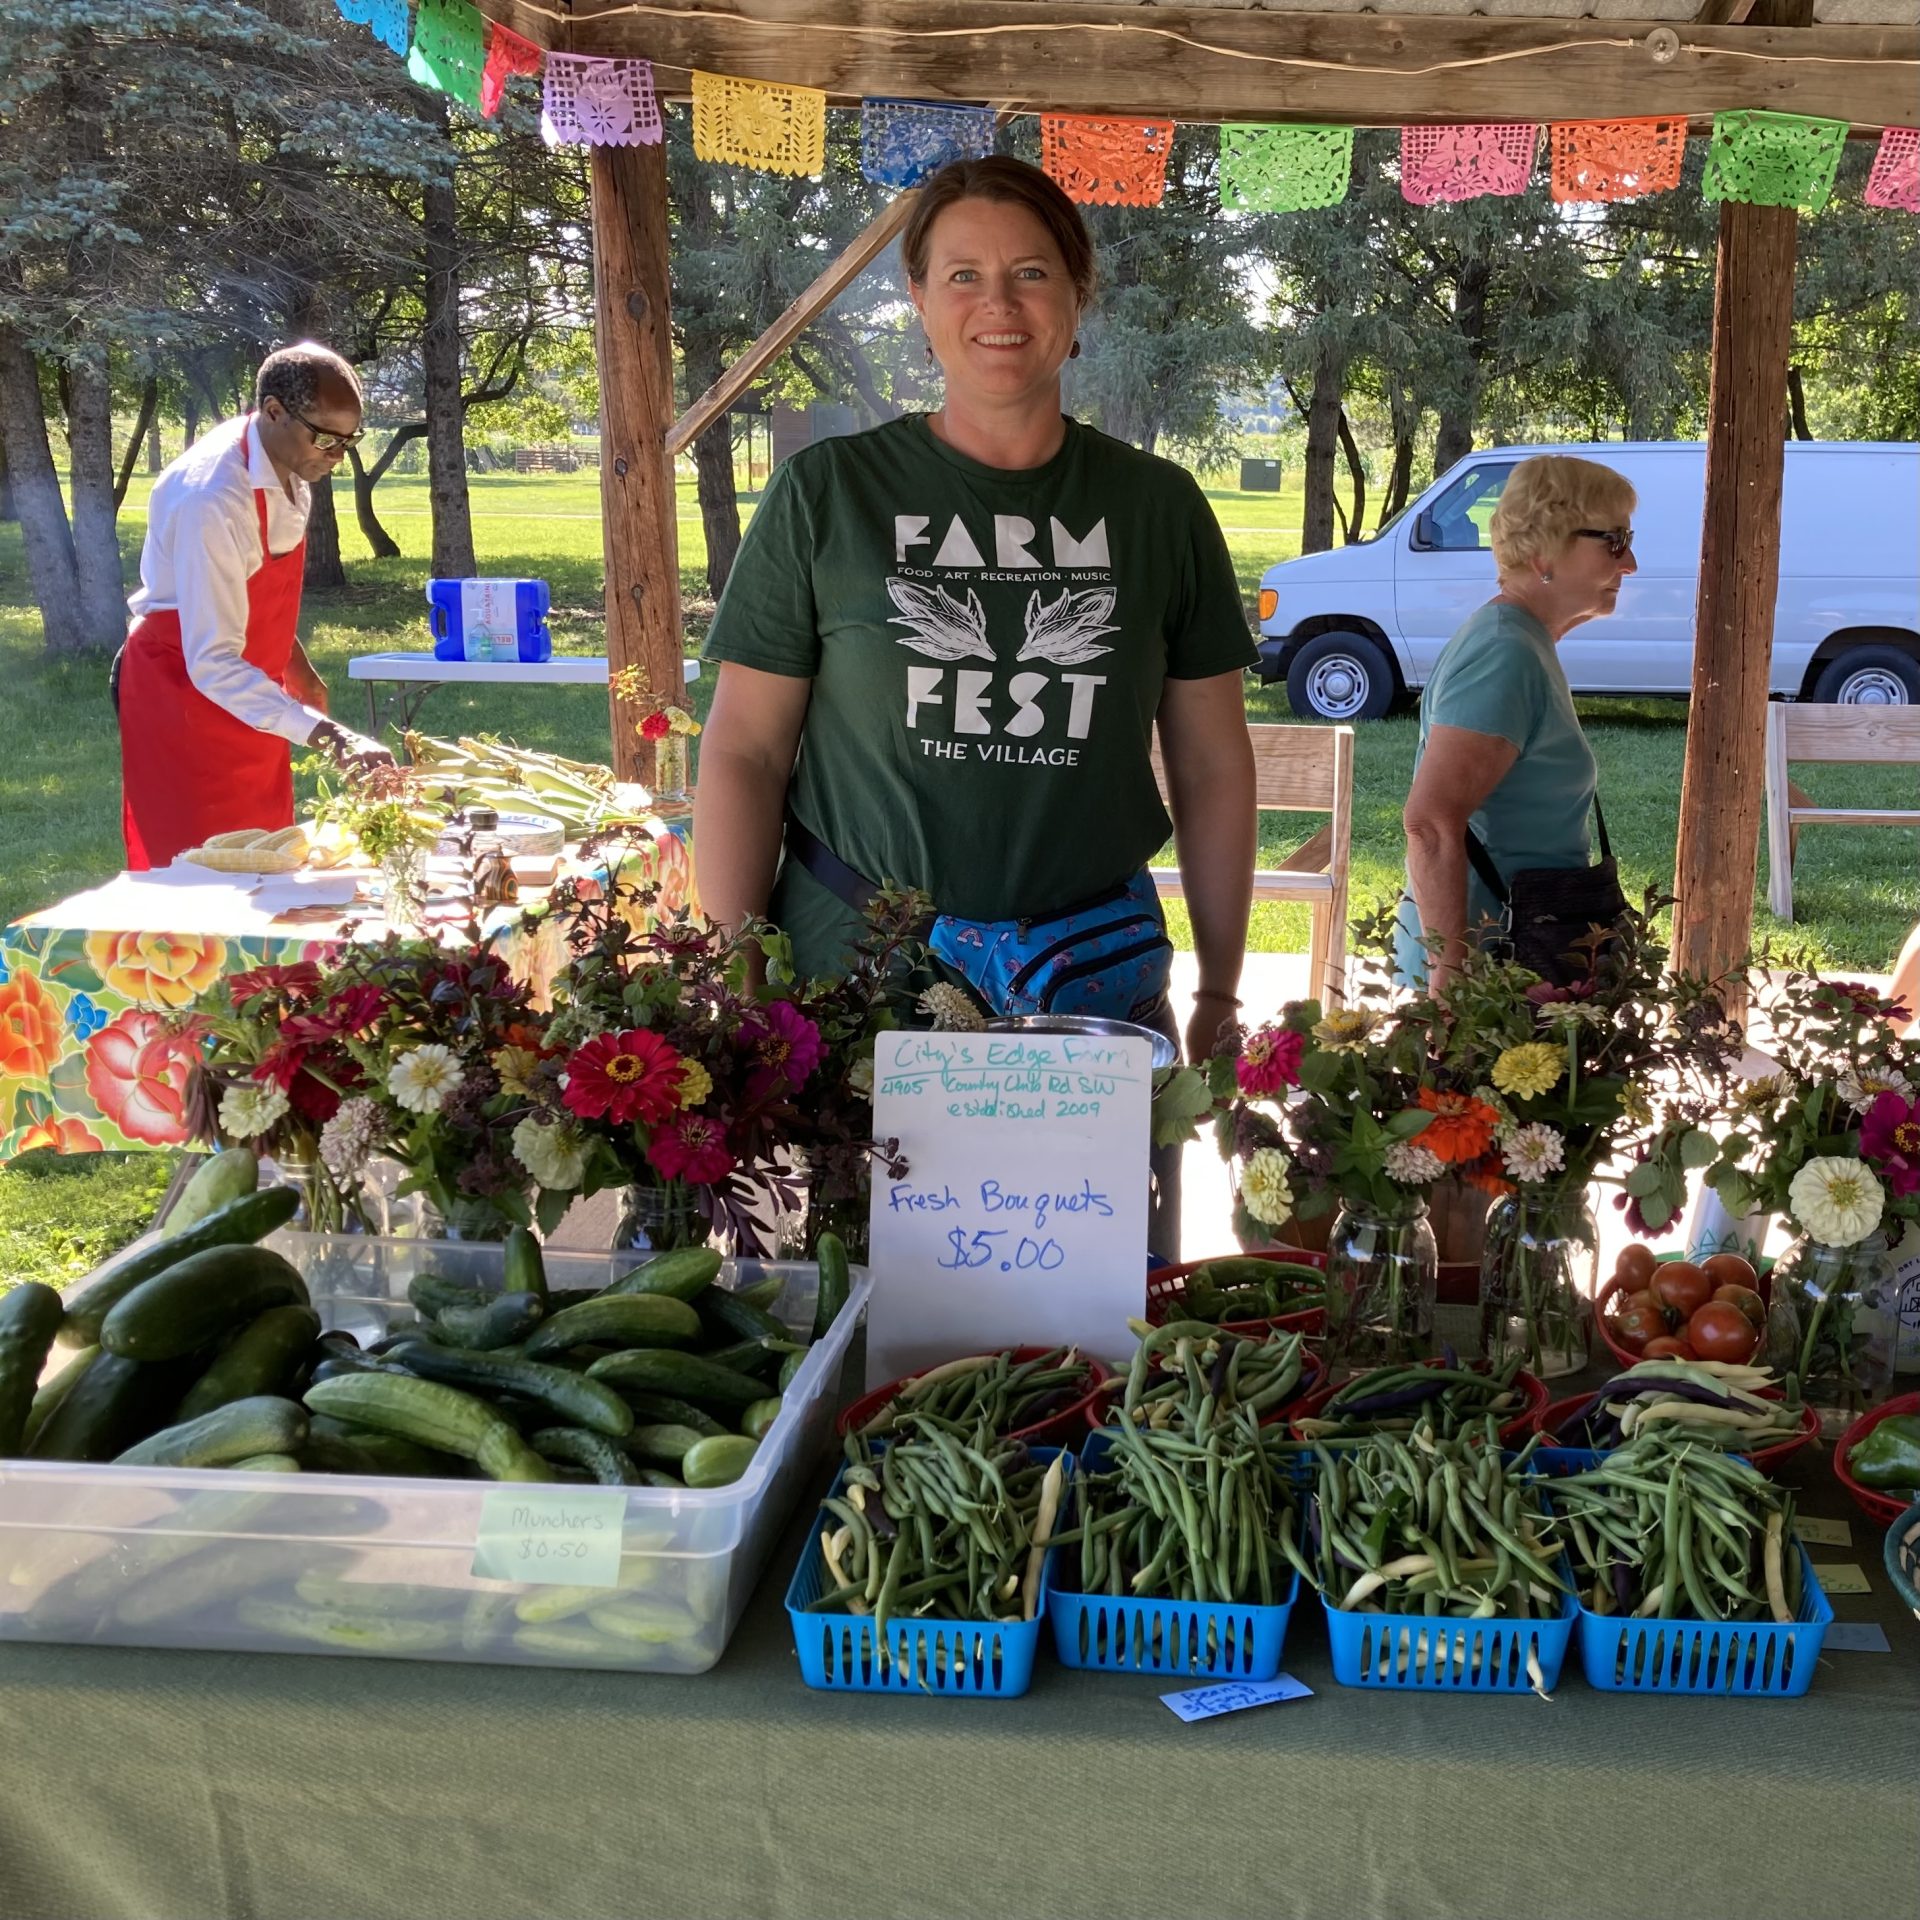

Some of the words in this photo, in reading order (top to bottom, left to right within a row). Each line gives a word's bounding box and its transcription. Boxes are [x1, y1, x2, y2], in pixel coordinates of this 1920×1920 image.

[895, 513, 1111, 567] FARM
[897, 567, 934, 579] FOOD
[944, 571, 970, 581] ART
[980, 571, 1061, 582] RECREATION
[1071, 572, 1112, 582] MUSIC
[906, 665, 1107, 739] FEST
[920, 738, 968, 760] THE
[976, 743, 1080, 766] VILLAGE
[894, 1039, 974, 1086] City's
[987, 1042, 1057, 1079] Edge
[880, 1078, 931, 1096] 4905
[1080, 1077, 1116, 1096] SW
[1055, 1101, 1101, 1117] 2009
[888, 1184, 961, 1213] Fresh
[980, 1179, 1114, 1230] Bouquets
[937, 1225, 1065, 1272] $5.00
[511, 1507, 605, 1530] Munchers
[518, 1534, 589, 1560] $0.50
